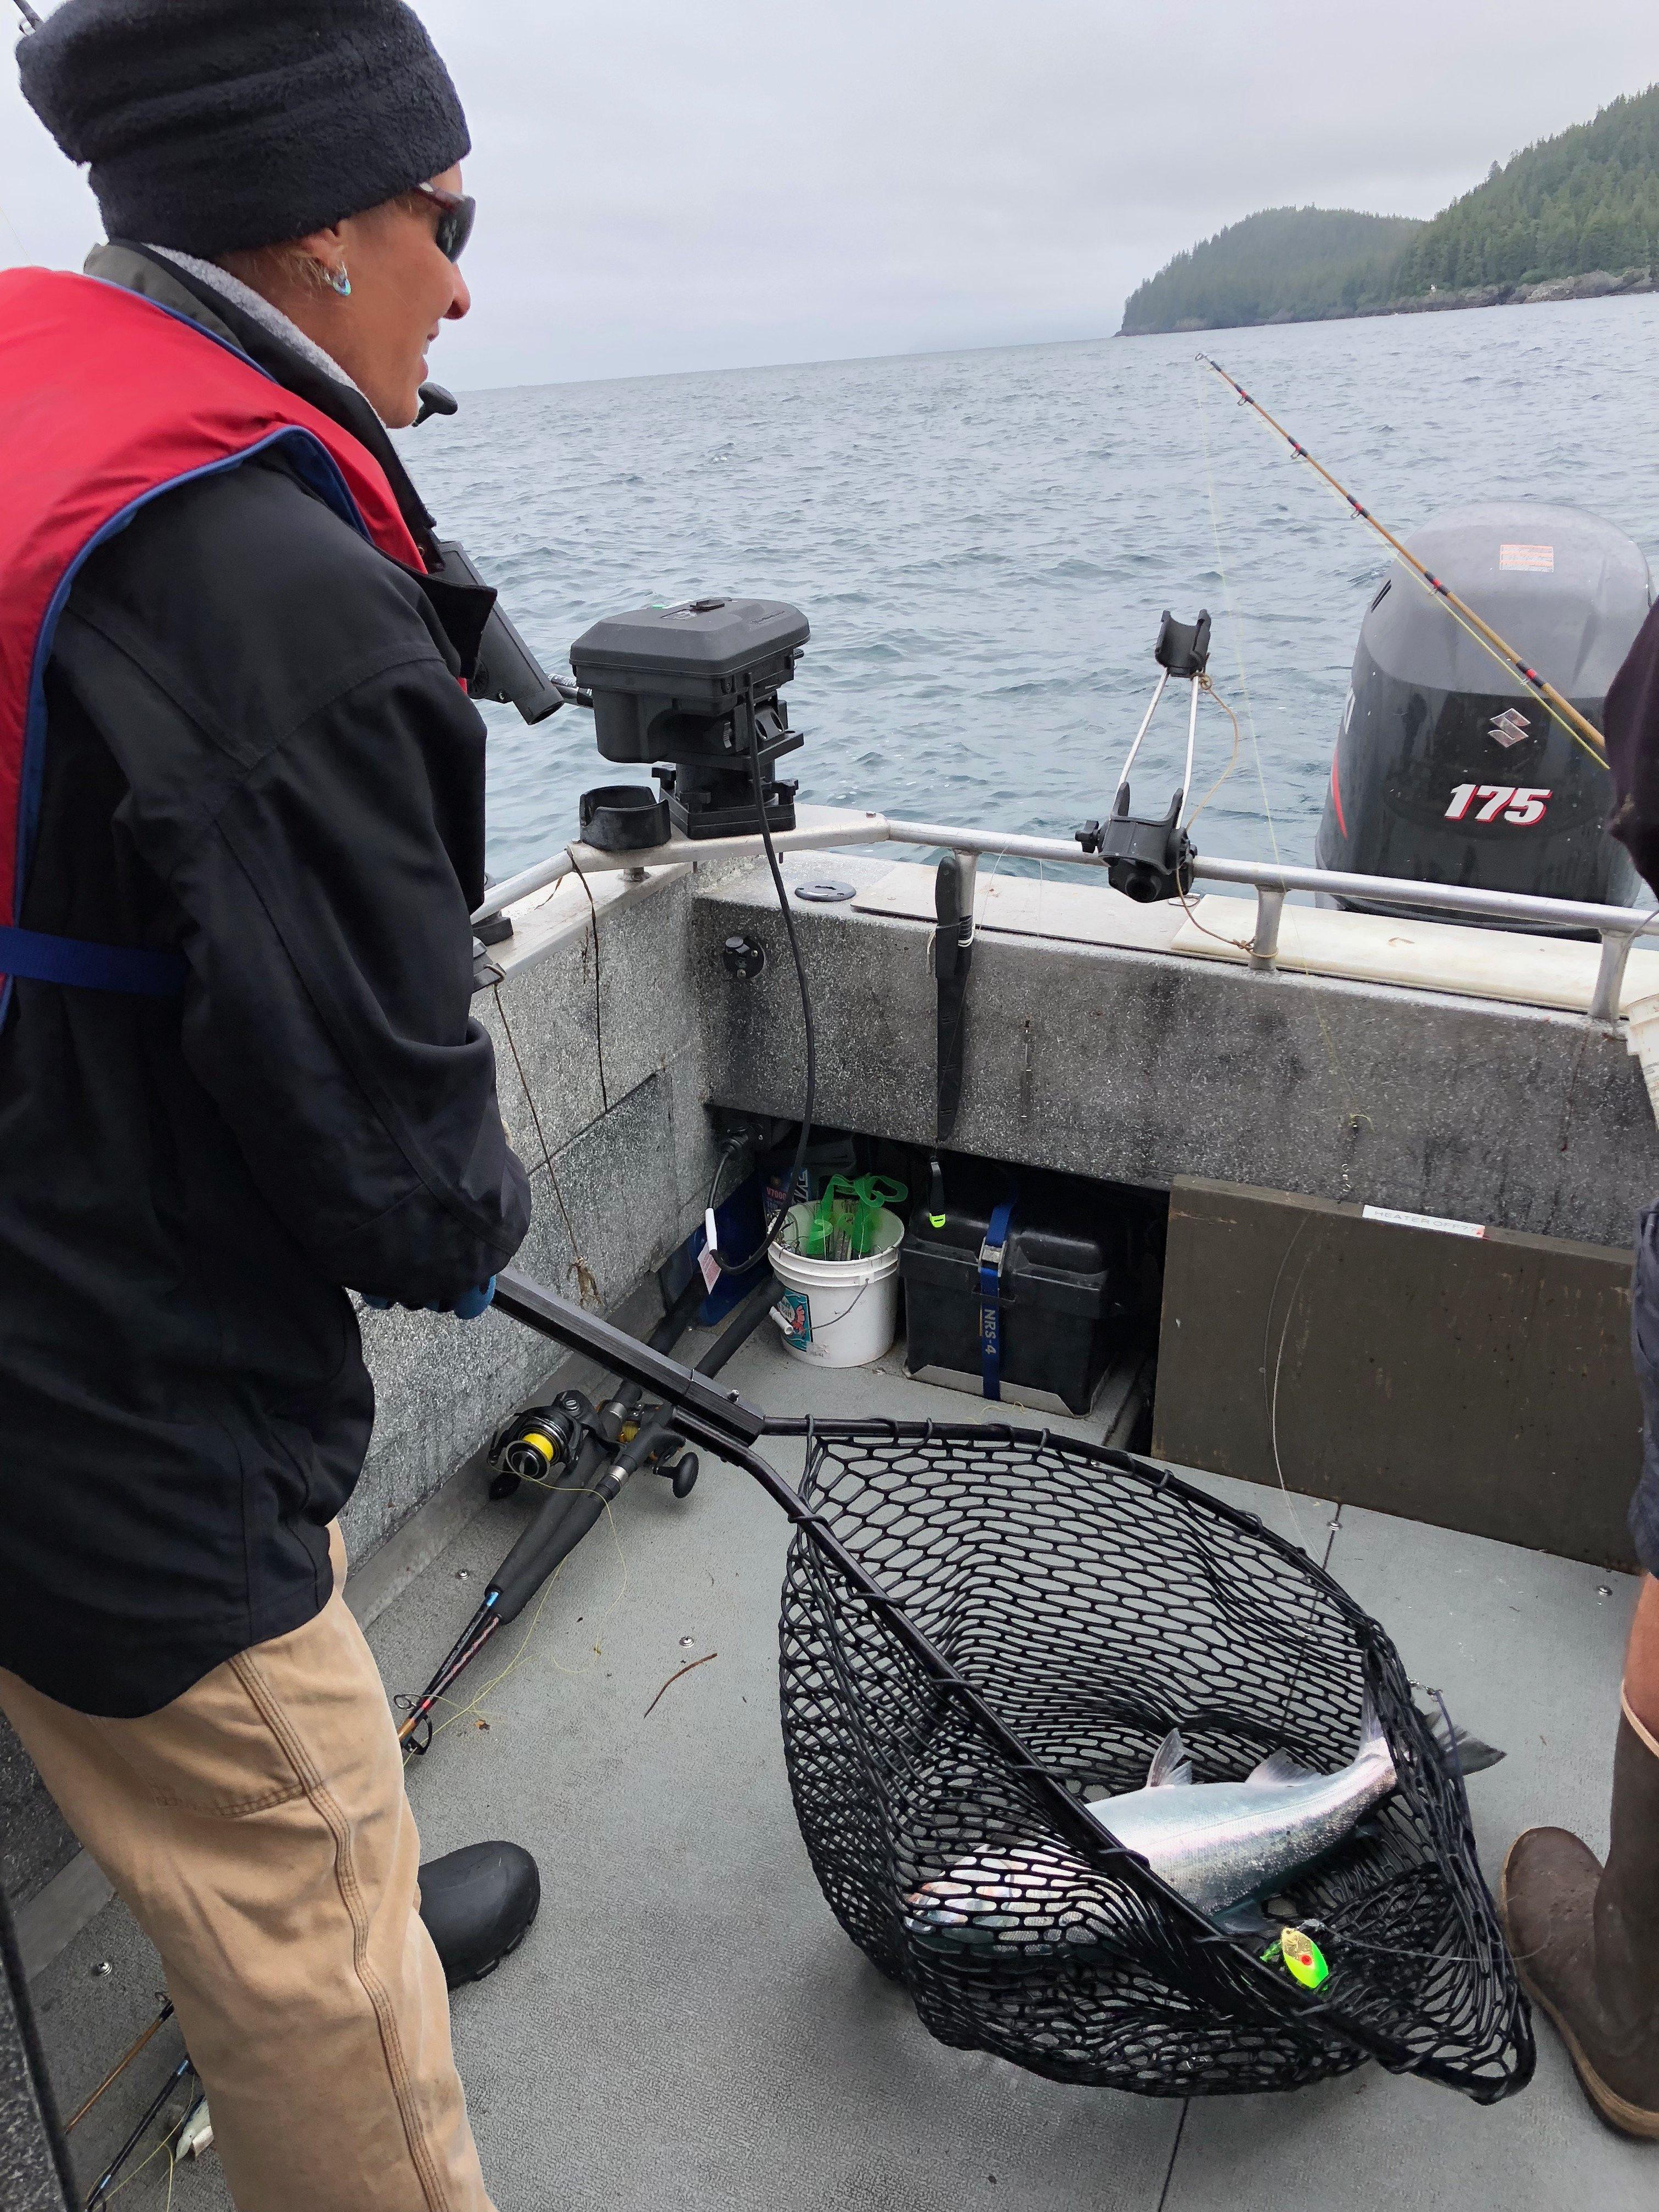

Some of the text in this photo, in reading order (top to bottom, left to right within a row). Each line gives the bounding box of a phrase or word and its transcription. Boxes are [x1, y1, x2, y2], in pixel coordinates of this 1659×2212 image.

[1444, 783, 1553, 827] 175
[1375, 1210, 1430, 1224] HEATER
[984, 1308, 996, 1355] NRS-4
